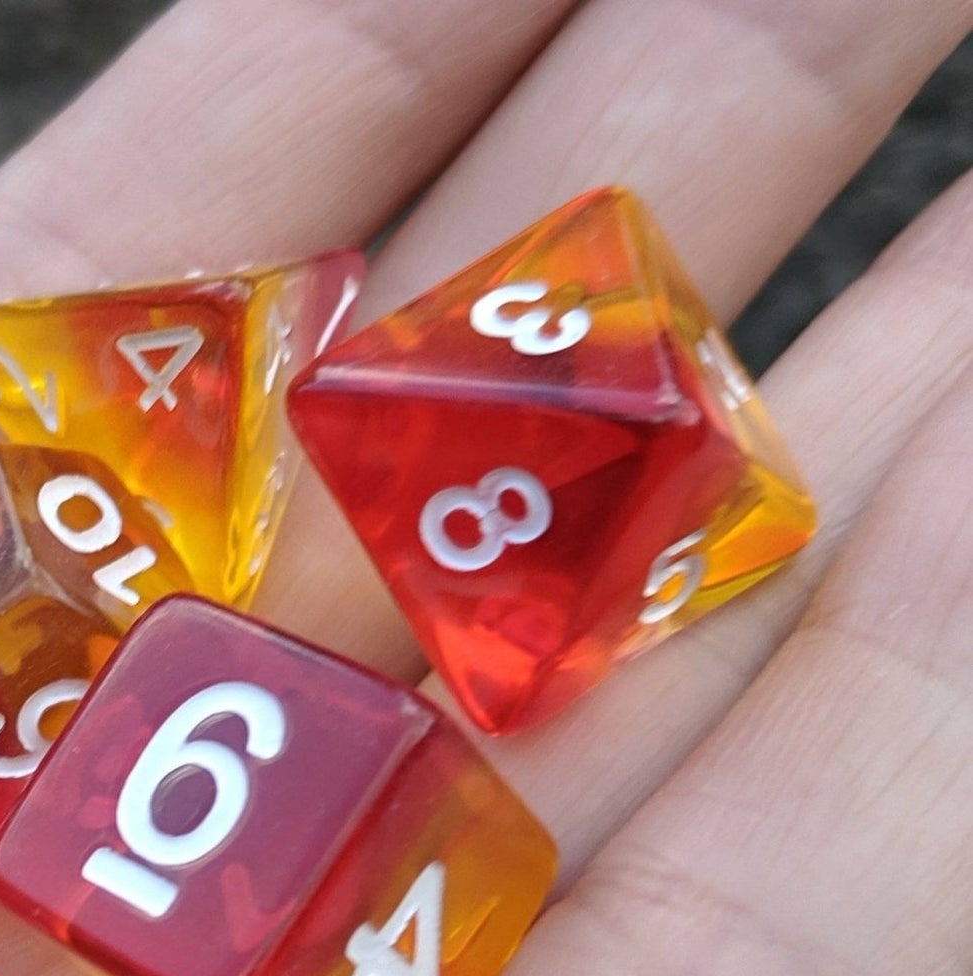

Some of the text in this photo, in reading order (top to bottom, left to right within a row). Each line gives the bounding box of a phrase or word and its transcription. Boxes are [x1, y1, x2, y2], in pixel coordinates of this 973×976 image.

[470, 281, 592, 356] 3
[116, 325, 205, 413] 4
[37, 474, 157, 605] 10
[418, 466, 553, 573] 8
[638, 530, 708, 624] 5
[81, 681, 286, 918] 6
